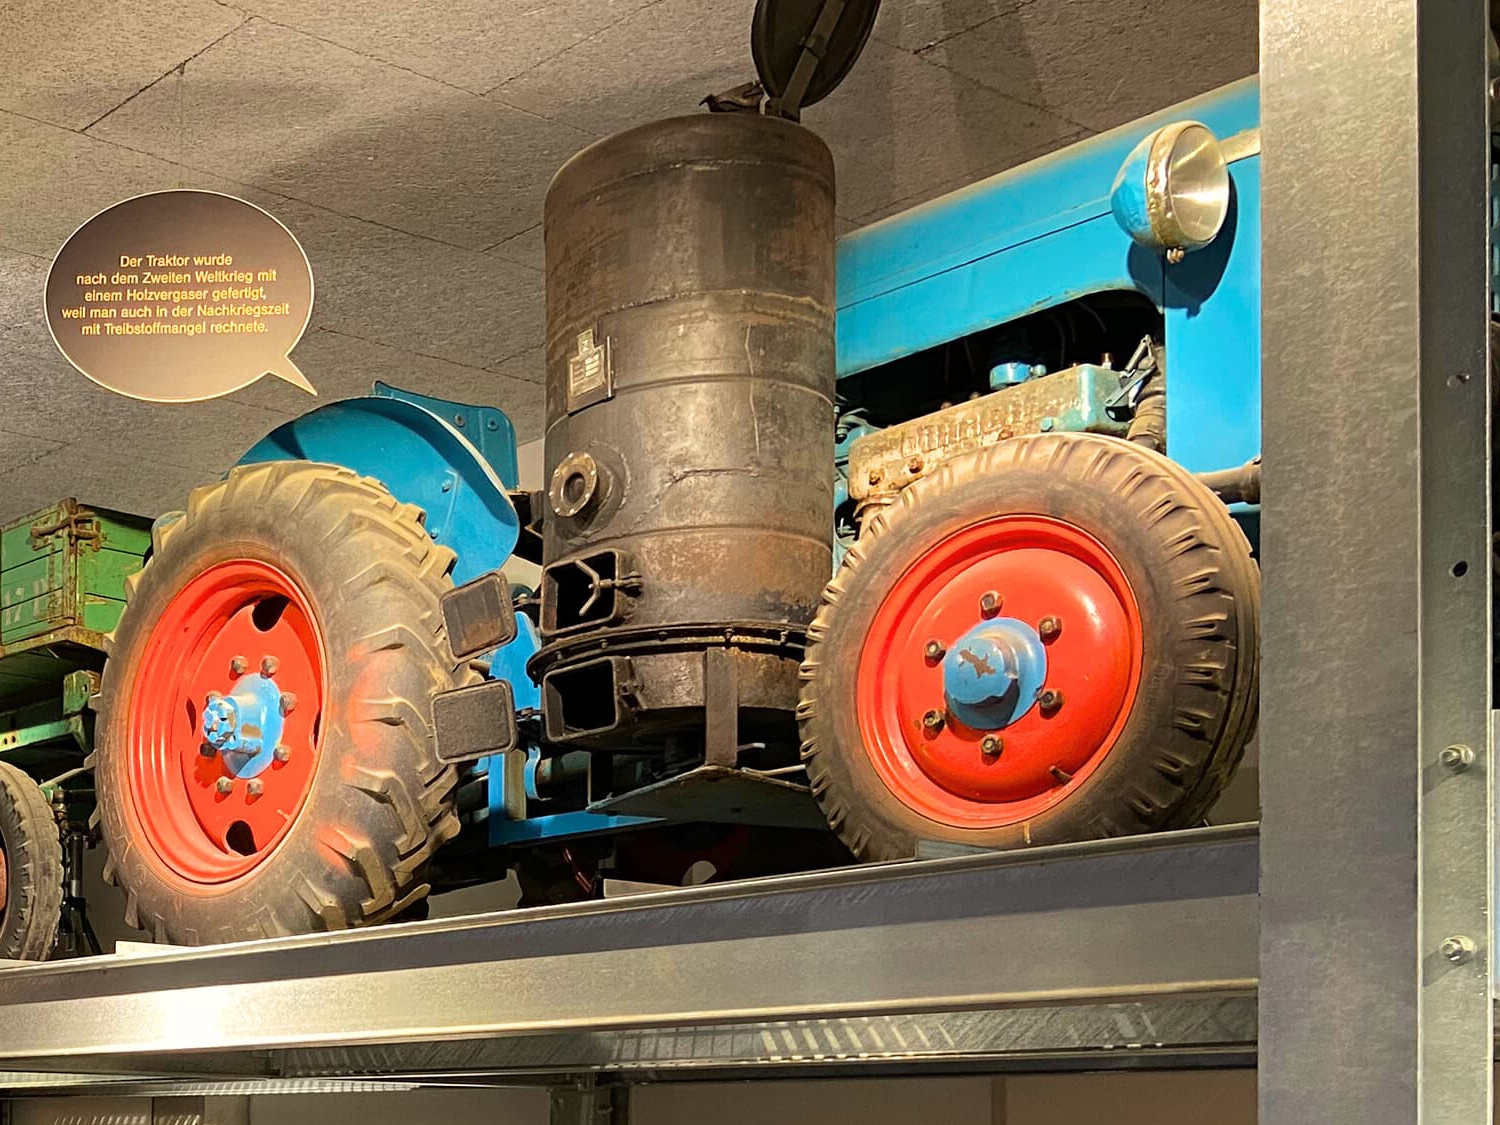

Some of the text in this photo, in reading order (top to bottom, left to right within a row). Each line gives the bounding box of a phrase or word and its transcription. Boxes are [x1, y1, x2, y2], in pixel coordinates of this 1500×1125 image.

[120, 254, 233, 268] Der Traktor wurde
[76, 269, 277, 285] nach dem Zweiten Weltkrieg mit
[84, 286, 267, 303] einem Holzvergaser gefertigt,
[62, 303, 290, 319] weil man auch in der Nachkriegszeit
[81, 320, 268, 337] mit Treibstoffmangel rechnete.
